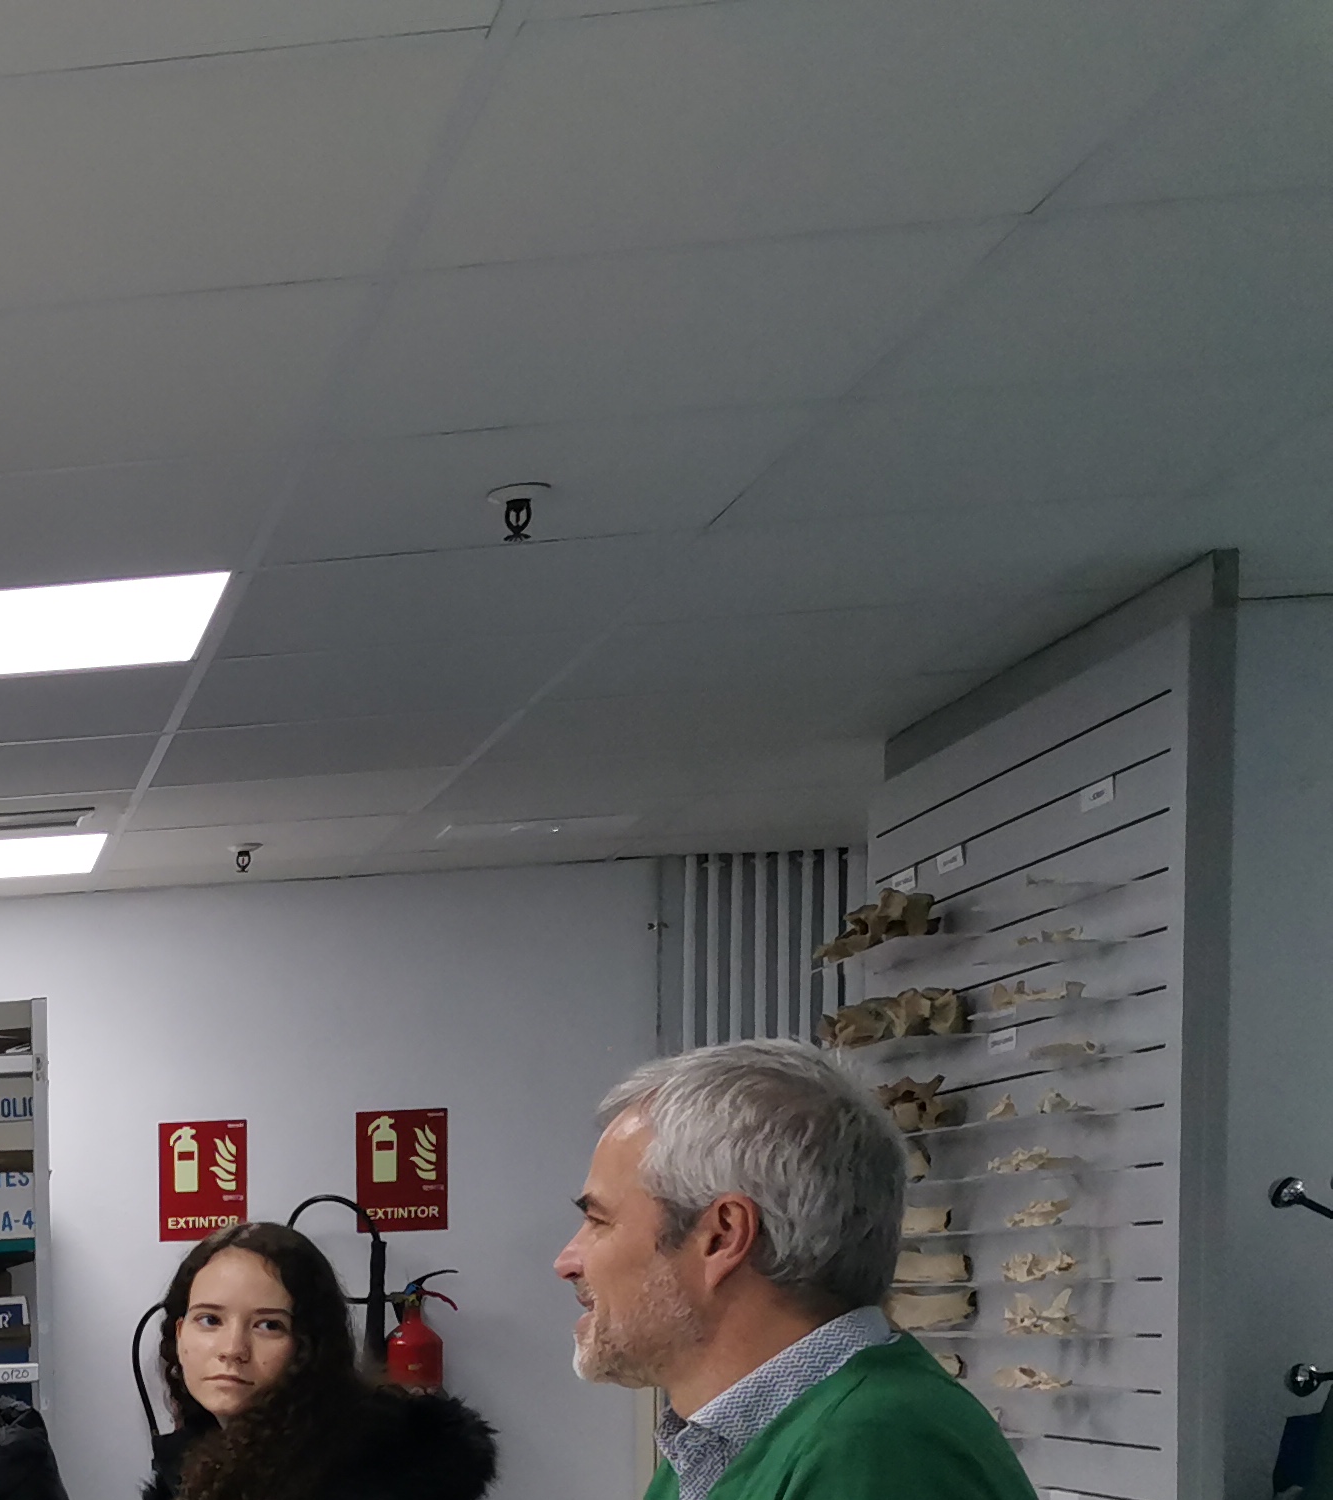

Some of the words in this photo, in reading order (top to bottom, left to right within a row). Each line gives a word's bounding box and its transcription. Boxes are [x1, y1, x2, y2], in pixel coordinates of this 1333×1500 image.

[365, 1205, 439, 1220] EXTINTOR
[1, 1210, 34, 1232] A-4
[167, 1215, 240, 1230] EXTINTOR
